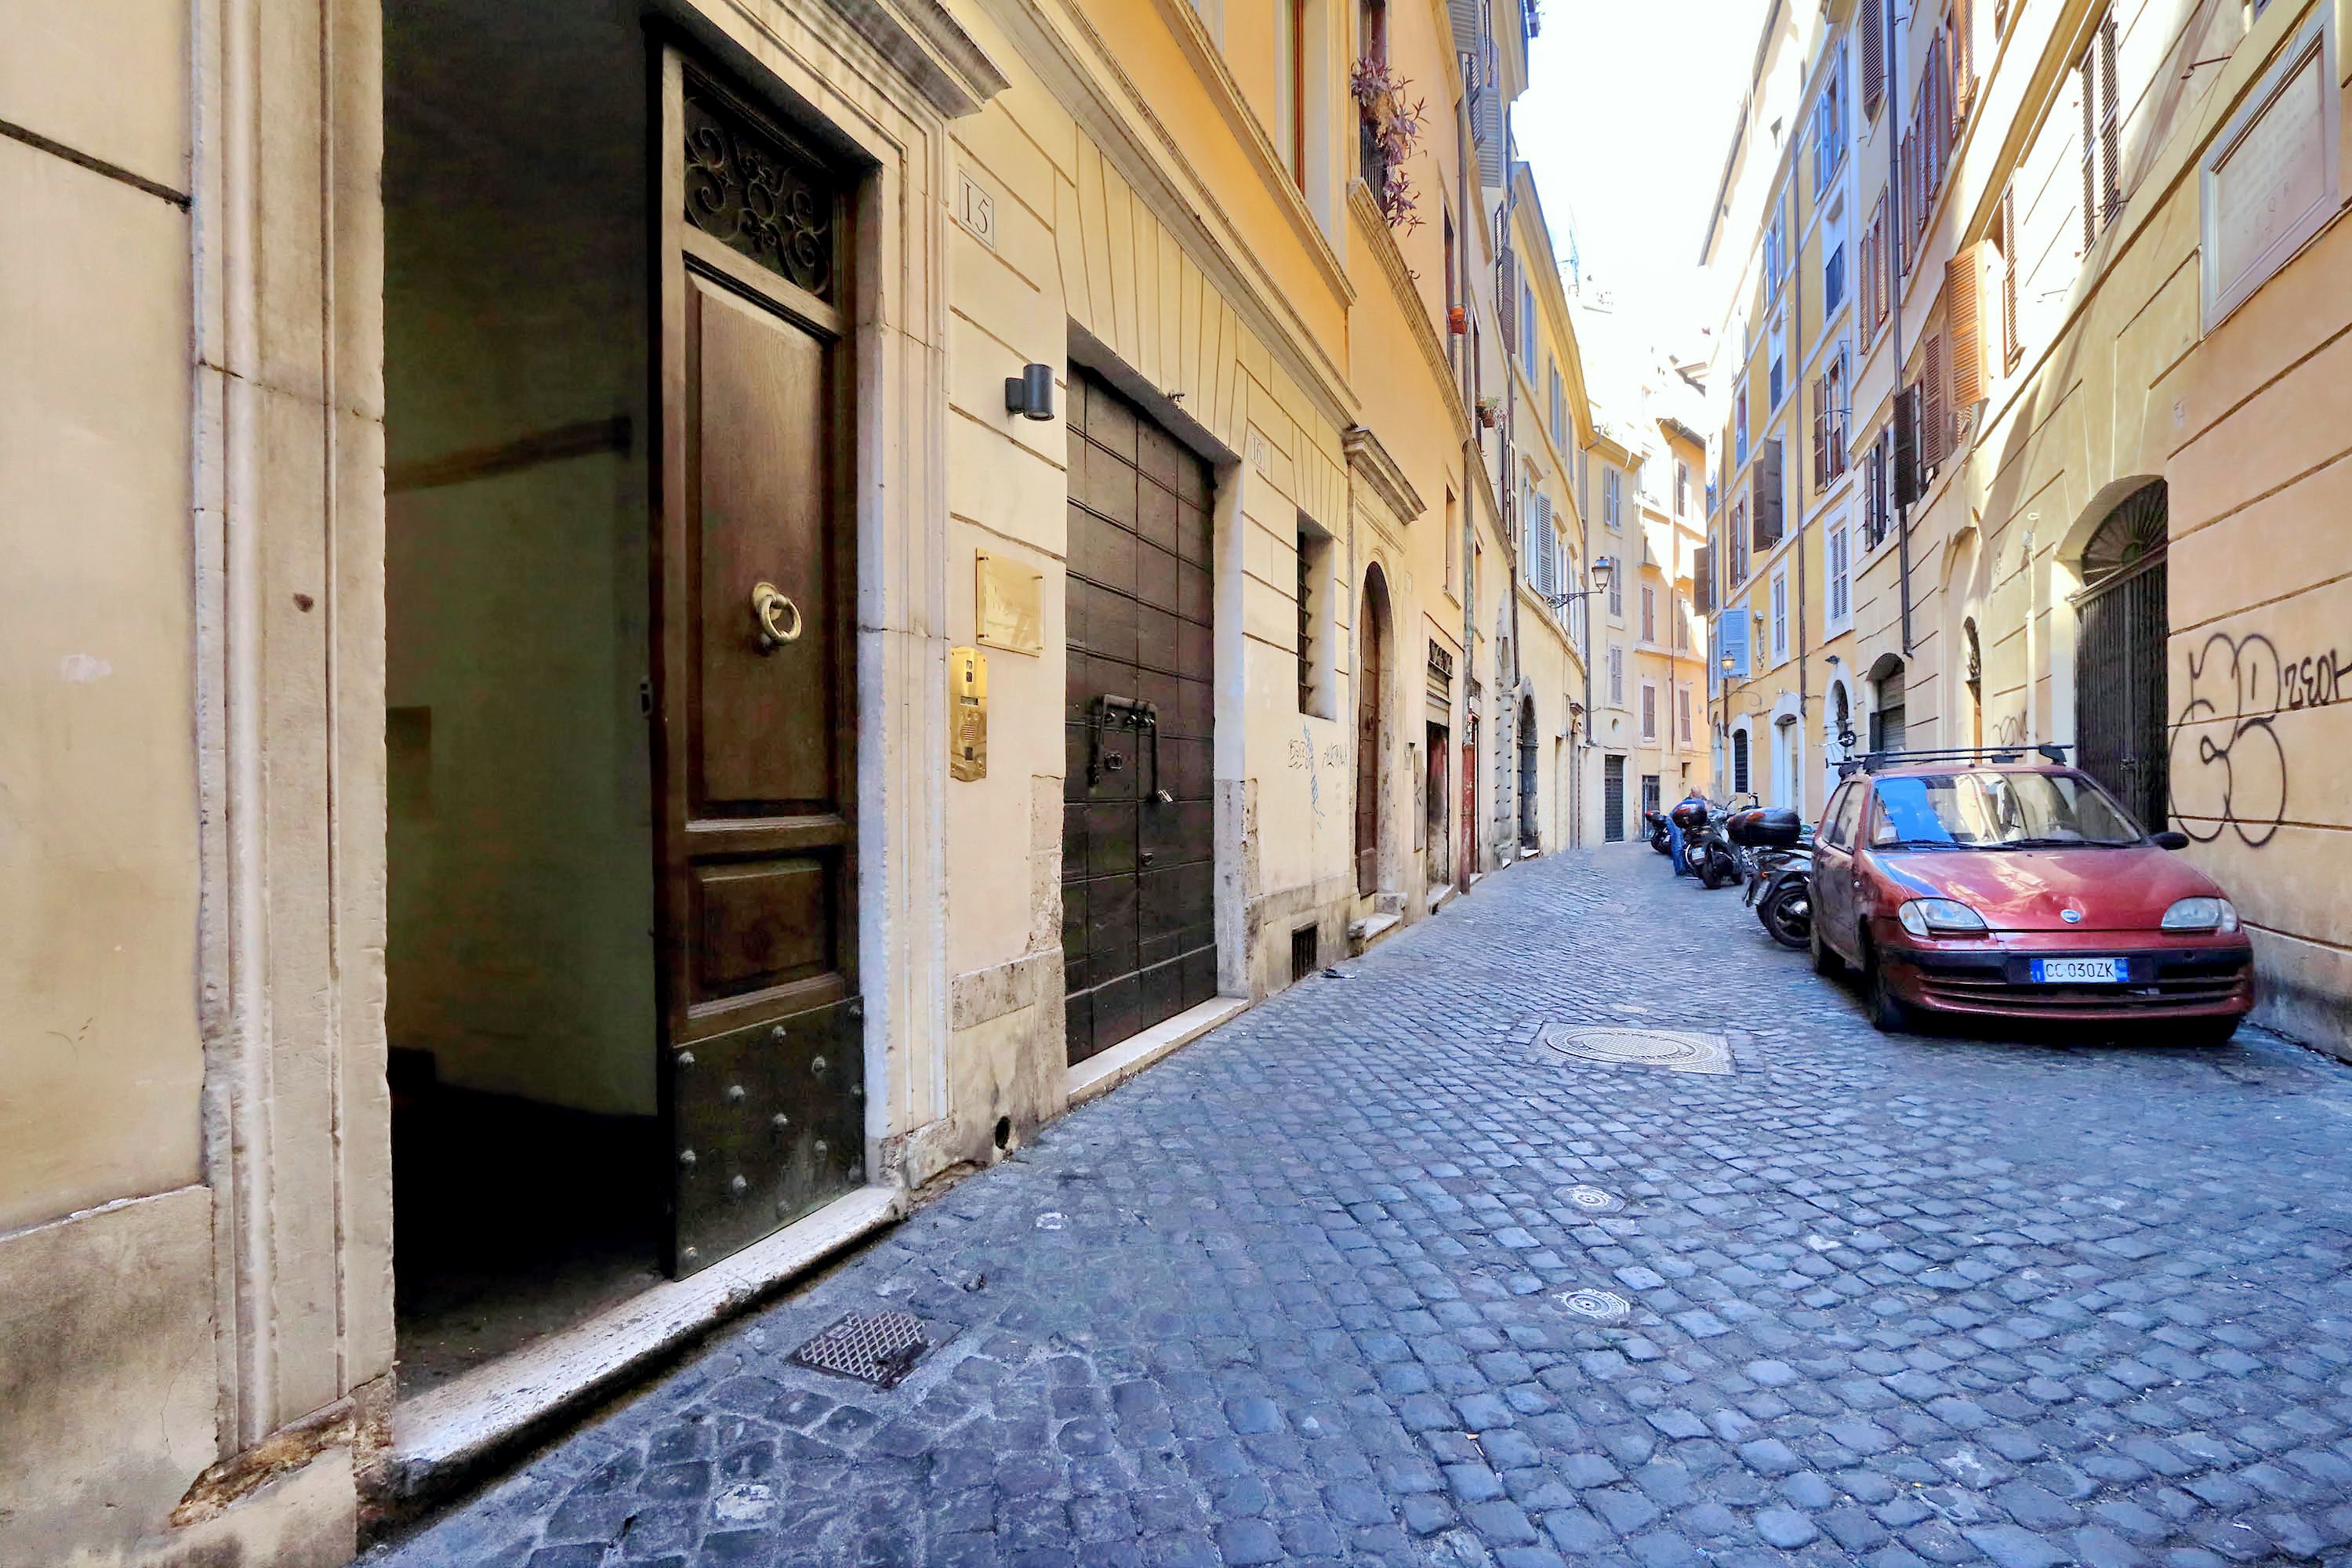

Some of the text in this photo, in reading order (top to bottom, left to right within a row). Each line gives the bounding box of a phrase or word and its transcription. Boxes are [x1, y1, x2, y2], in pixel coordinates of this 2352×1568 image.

[964, 182, 989, 234] 15
[1253, 437, 1262, 464] 16
[2045, 963, 2114, 978] CC 030ZK
